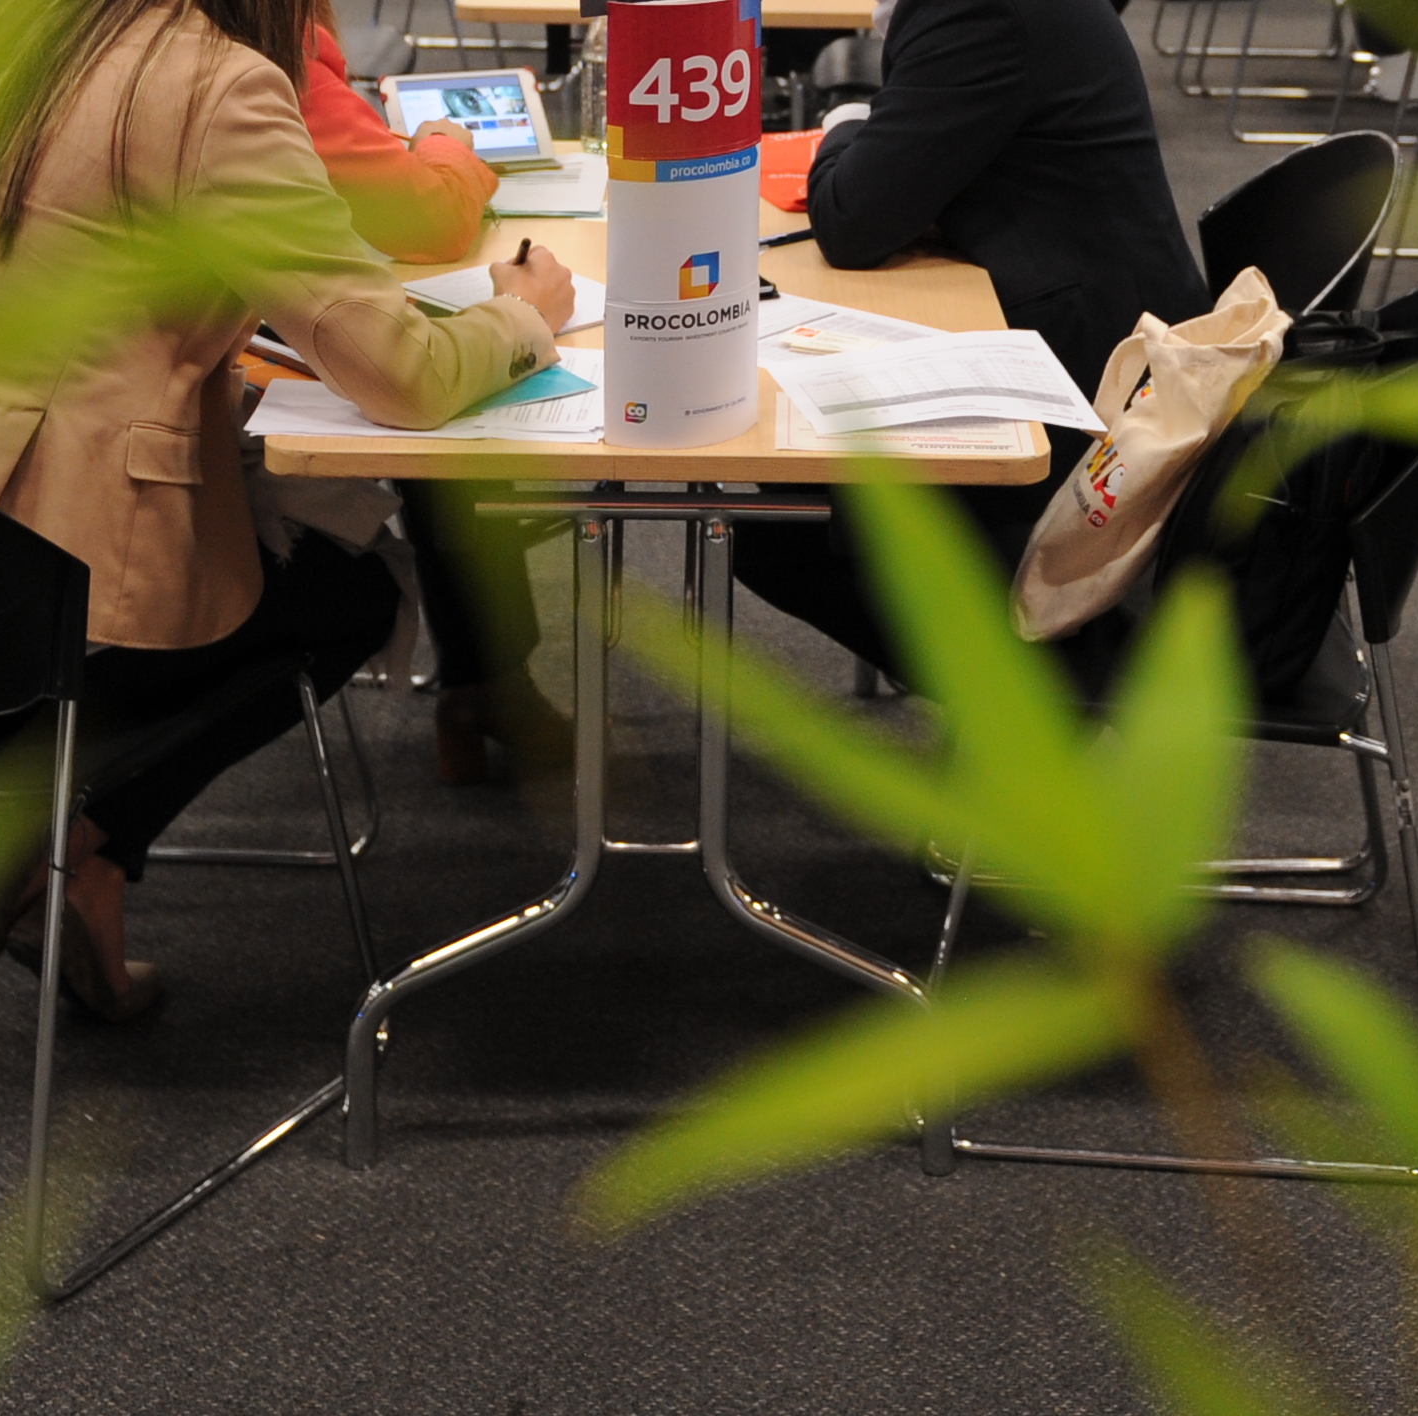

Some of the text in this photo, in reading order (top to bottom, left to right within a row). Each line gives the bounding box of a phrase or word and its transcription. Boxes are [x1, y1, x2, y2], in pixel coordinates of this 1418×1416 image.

[629, 49, 751, 123] 439
[670, 155, 751, 180] procolombia.co
[624, 299, 751, 330] PROCOLOMBIA
